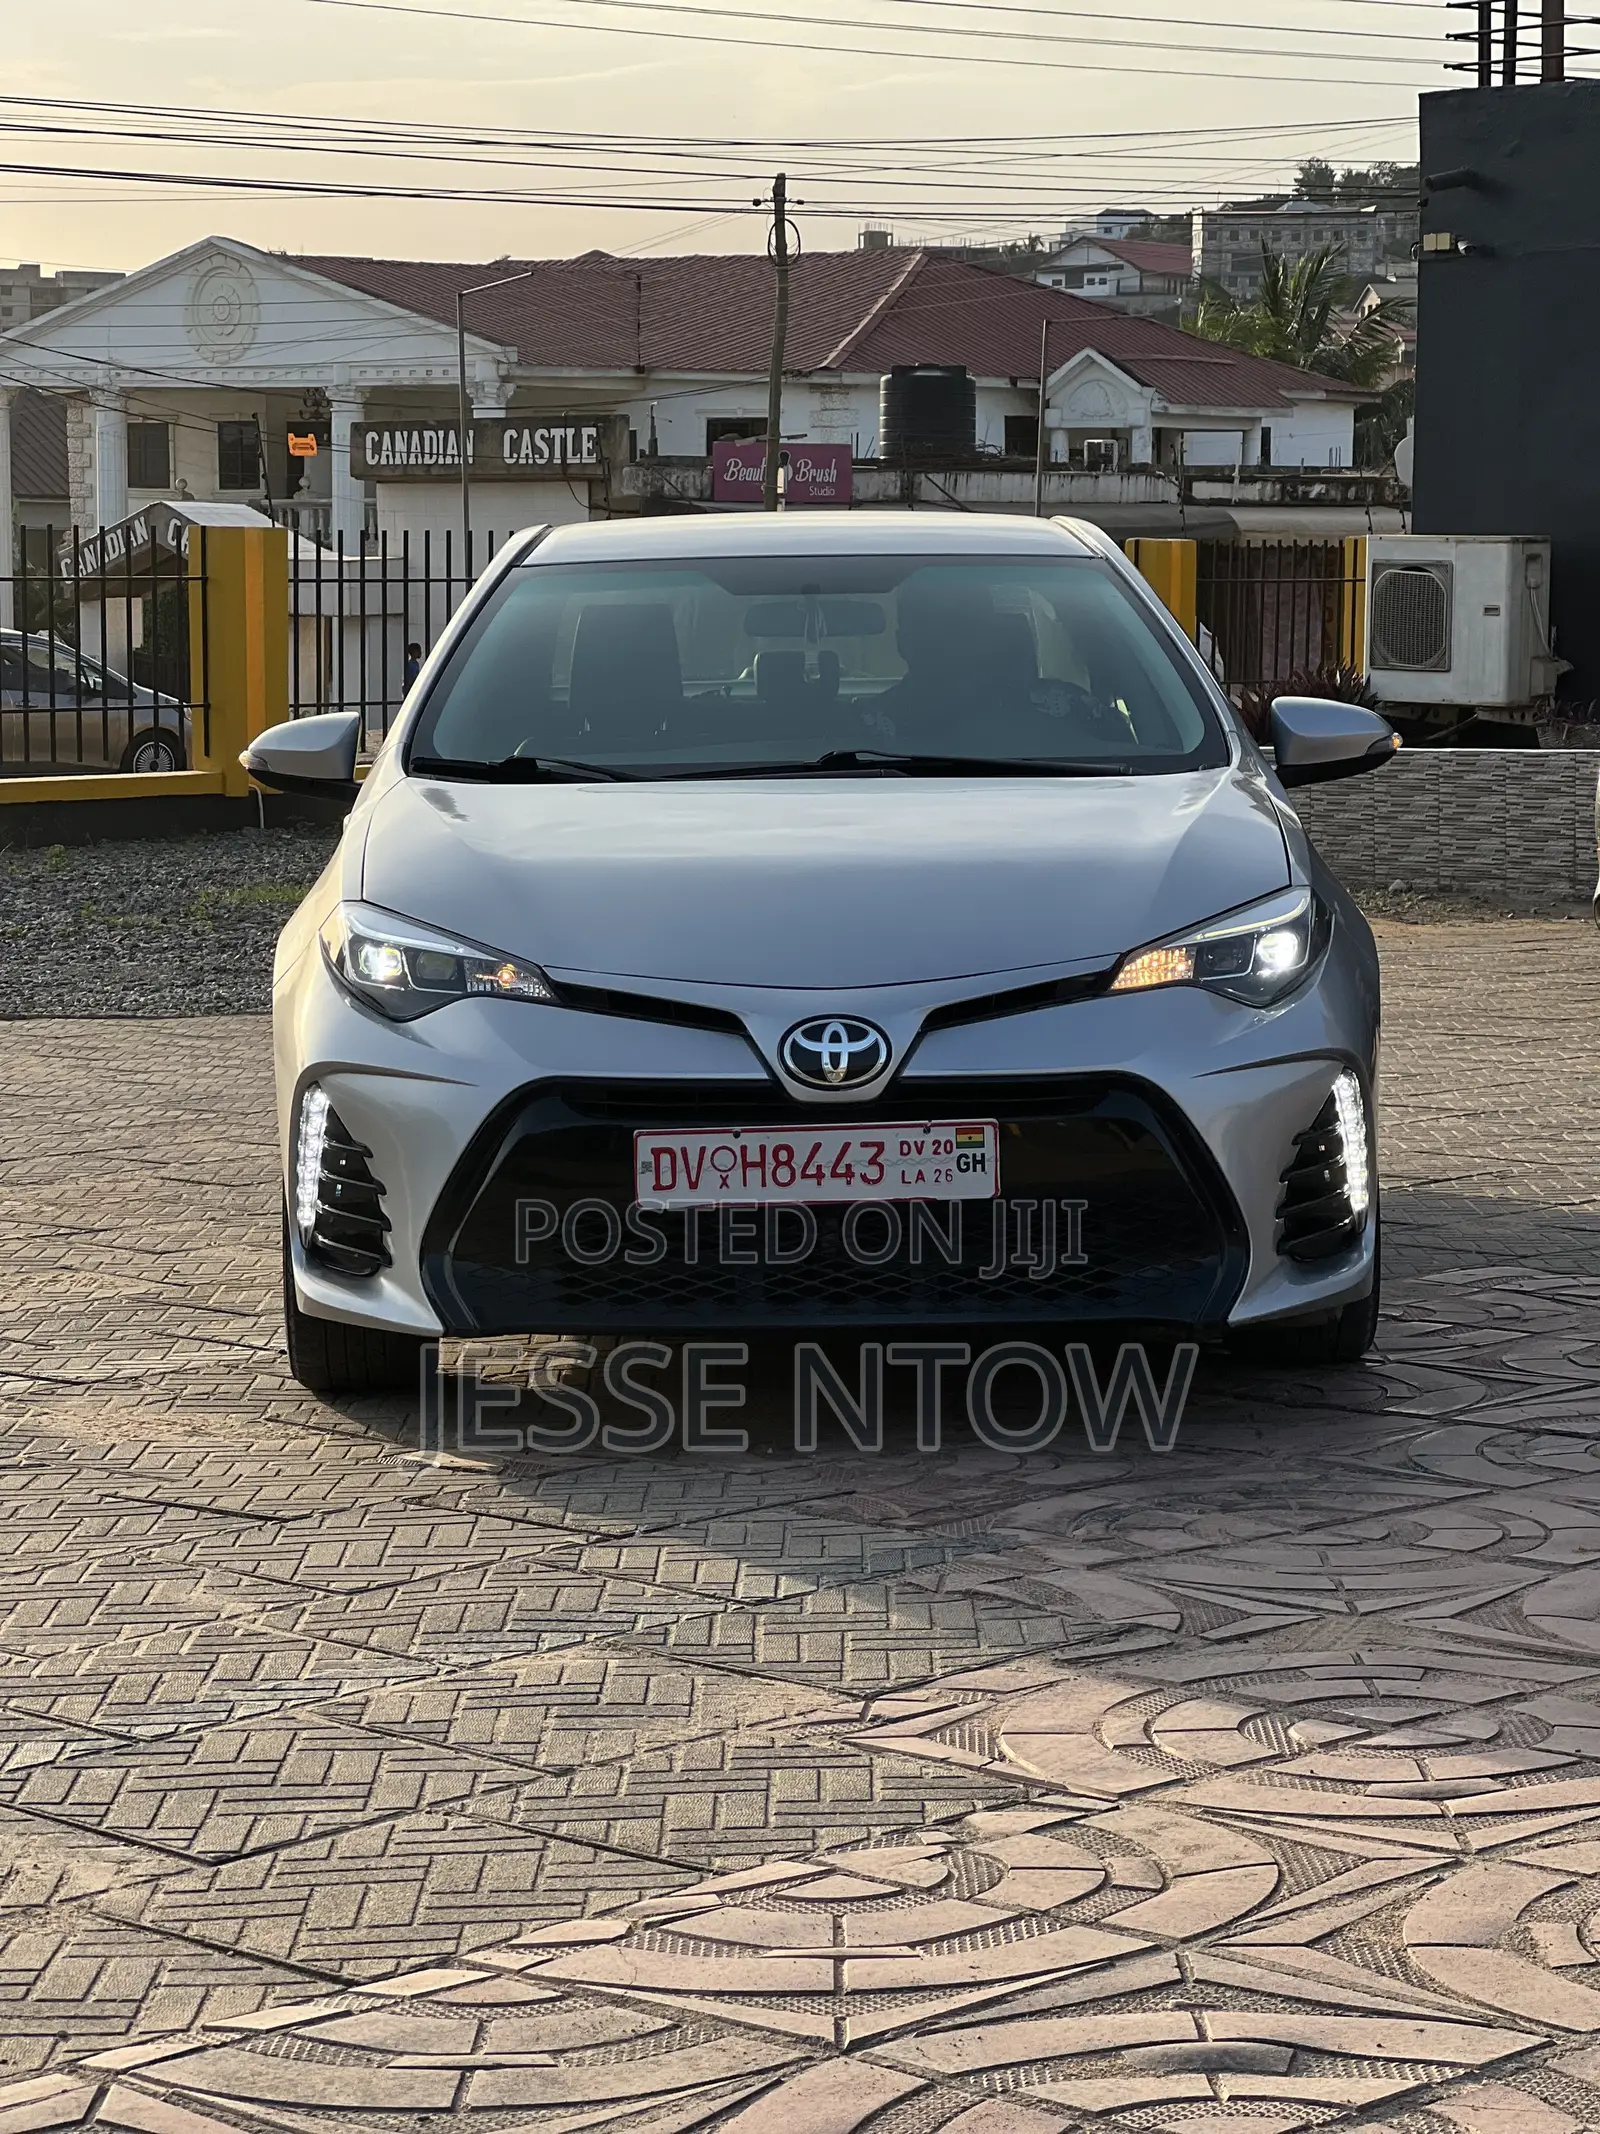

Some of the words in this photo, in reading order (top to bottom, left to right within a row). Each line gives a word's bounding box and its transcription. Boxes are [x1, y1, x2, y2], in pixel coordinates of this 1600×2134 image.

[503, 427, 597, 464] CASTLE
[723, 457, 766, 492] Beaut
[795, 458, 837, 483] Brush
[809, 485, 836, 496] Studio
[956, 1152, 987, 1174] GH
